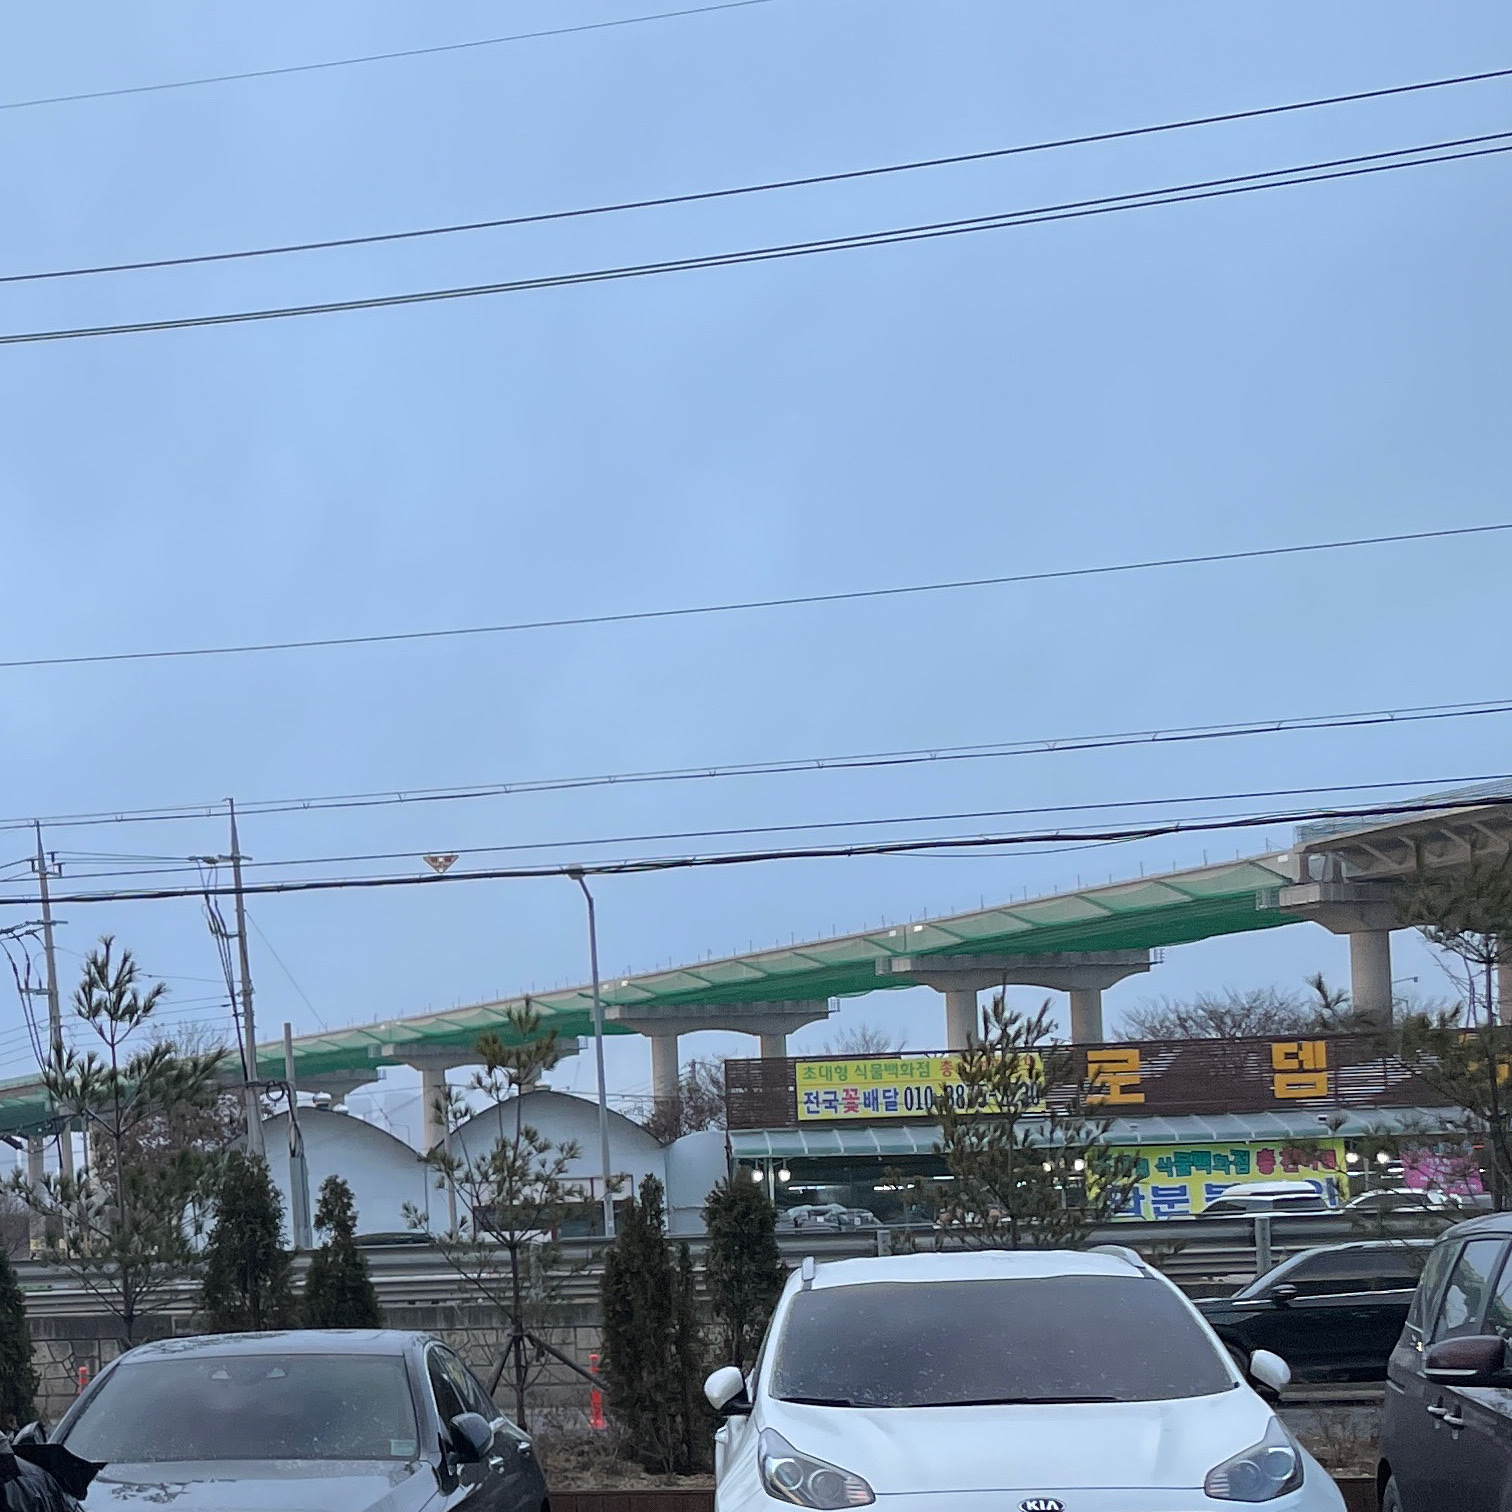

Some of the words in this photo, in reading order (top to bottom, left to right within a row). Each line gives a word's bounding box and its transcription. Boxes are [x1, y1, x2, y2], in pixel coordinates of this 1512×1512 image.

[802, 1064, 849, 1083] 초대형
[855, 1060, 931, 1081] 식물백화점
[1024, 1499, 1060, 1512] KIA
